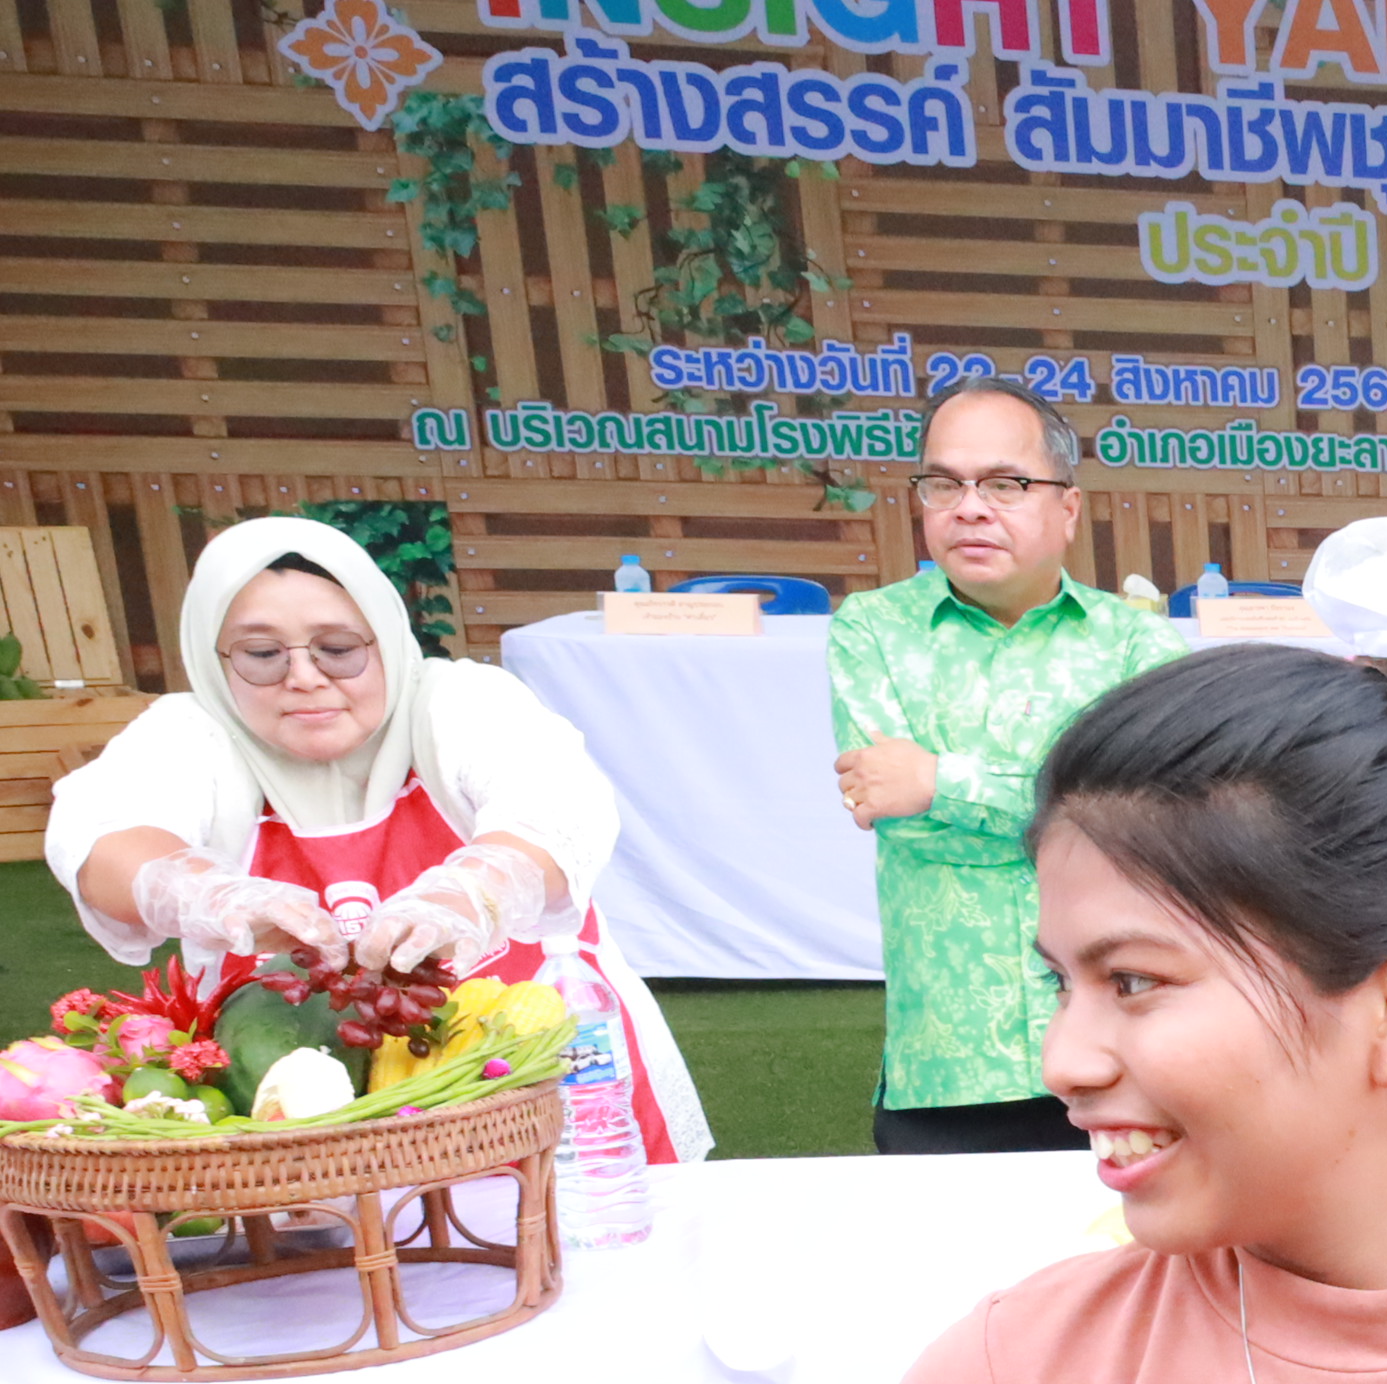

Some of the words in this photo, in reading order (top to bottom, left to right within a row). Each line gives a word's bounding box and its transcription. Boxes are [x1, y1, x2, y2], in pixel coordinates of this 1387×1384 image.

[490, 37, 967, 158] สร้างสรรค์
[1147, 208, 1371, 283] ประจำปี
[653, 335, 913, 395] ระหว่างวันที่
[1113, 357, 1278, 405] สิงหาคม
[416, 410, 467, 449] ณ
[488, 403, 922, 460] บริเวณสนามโรงพิธีช้
